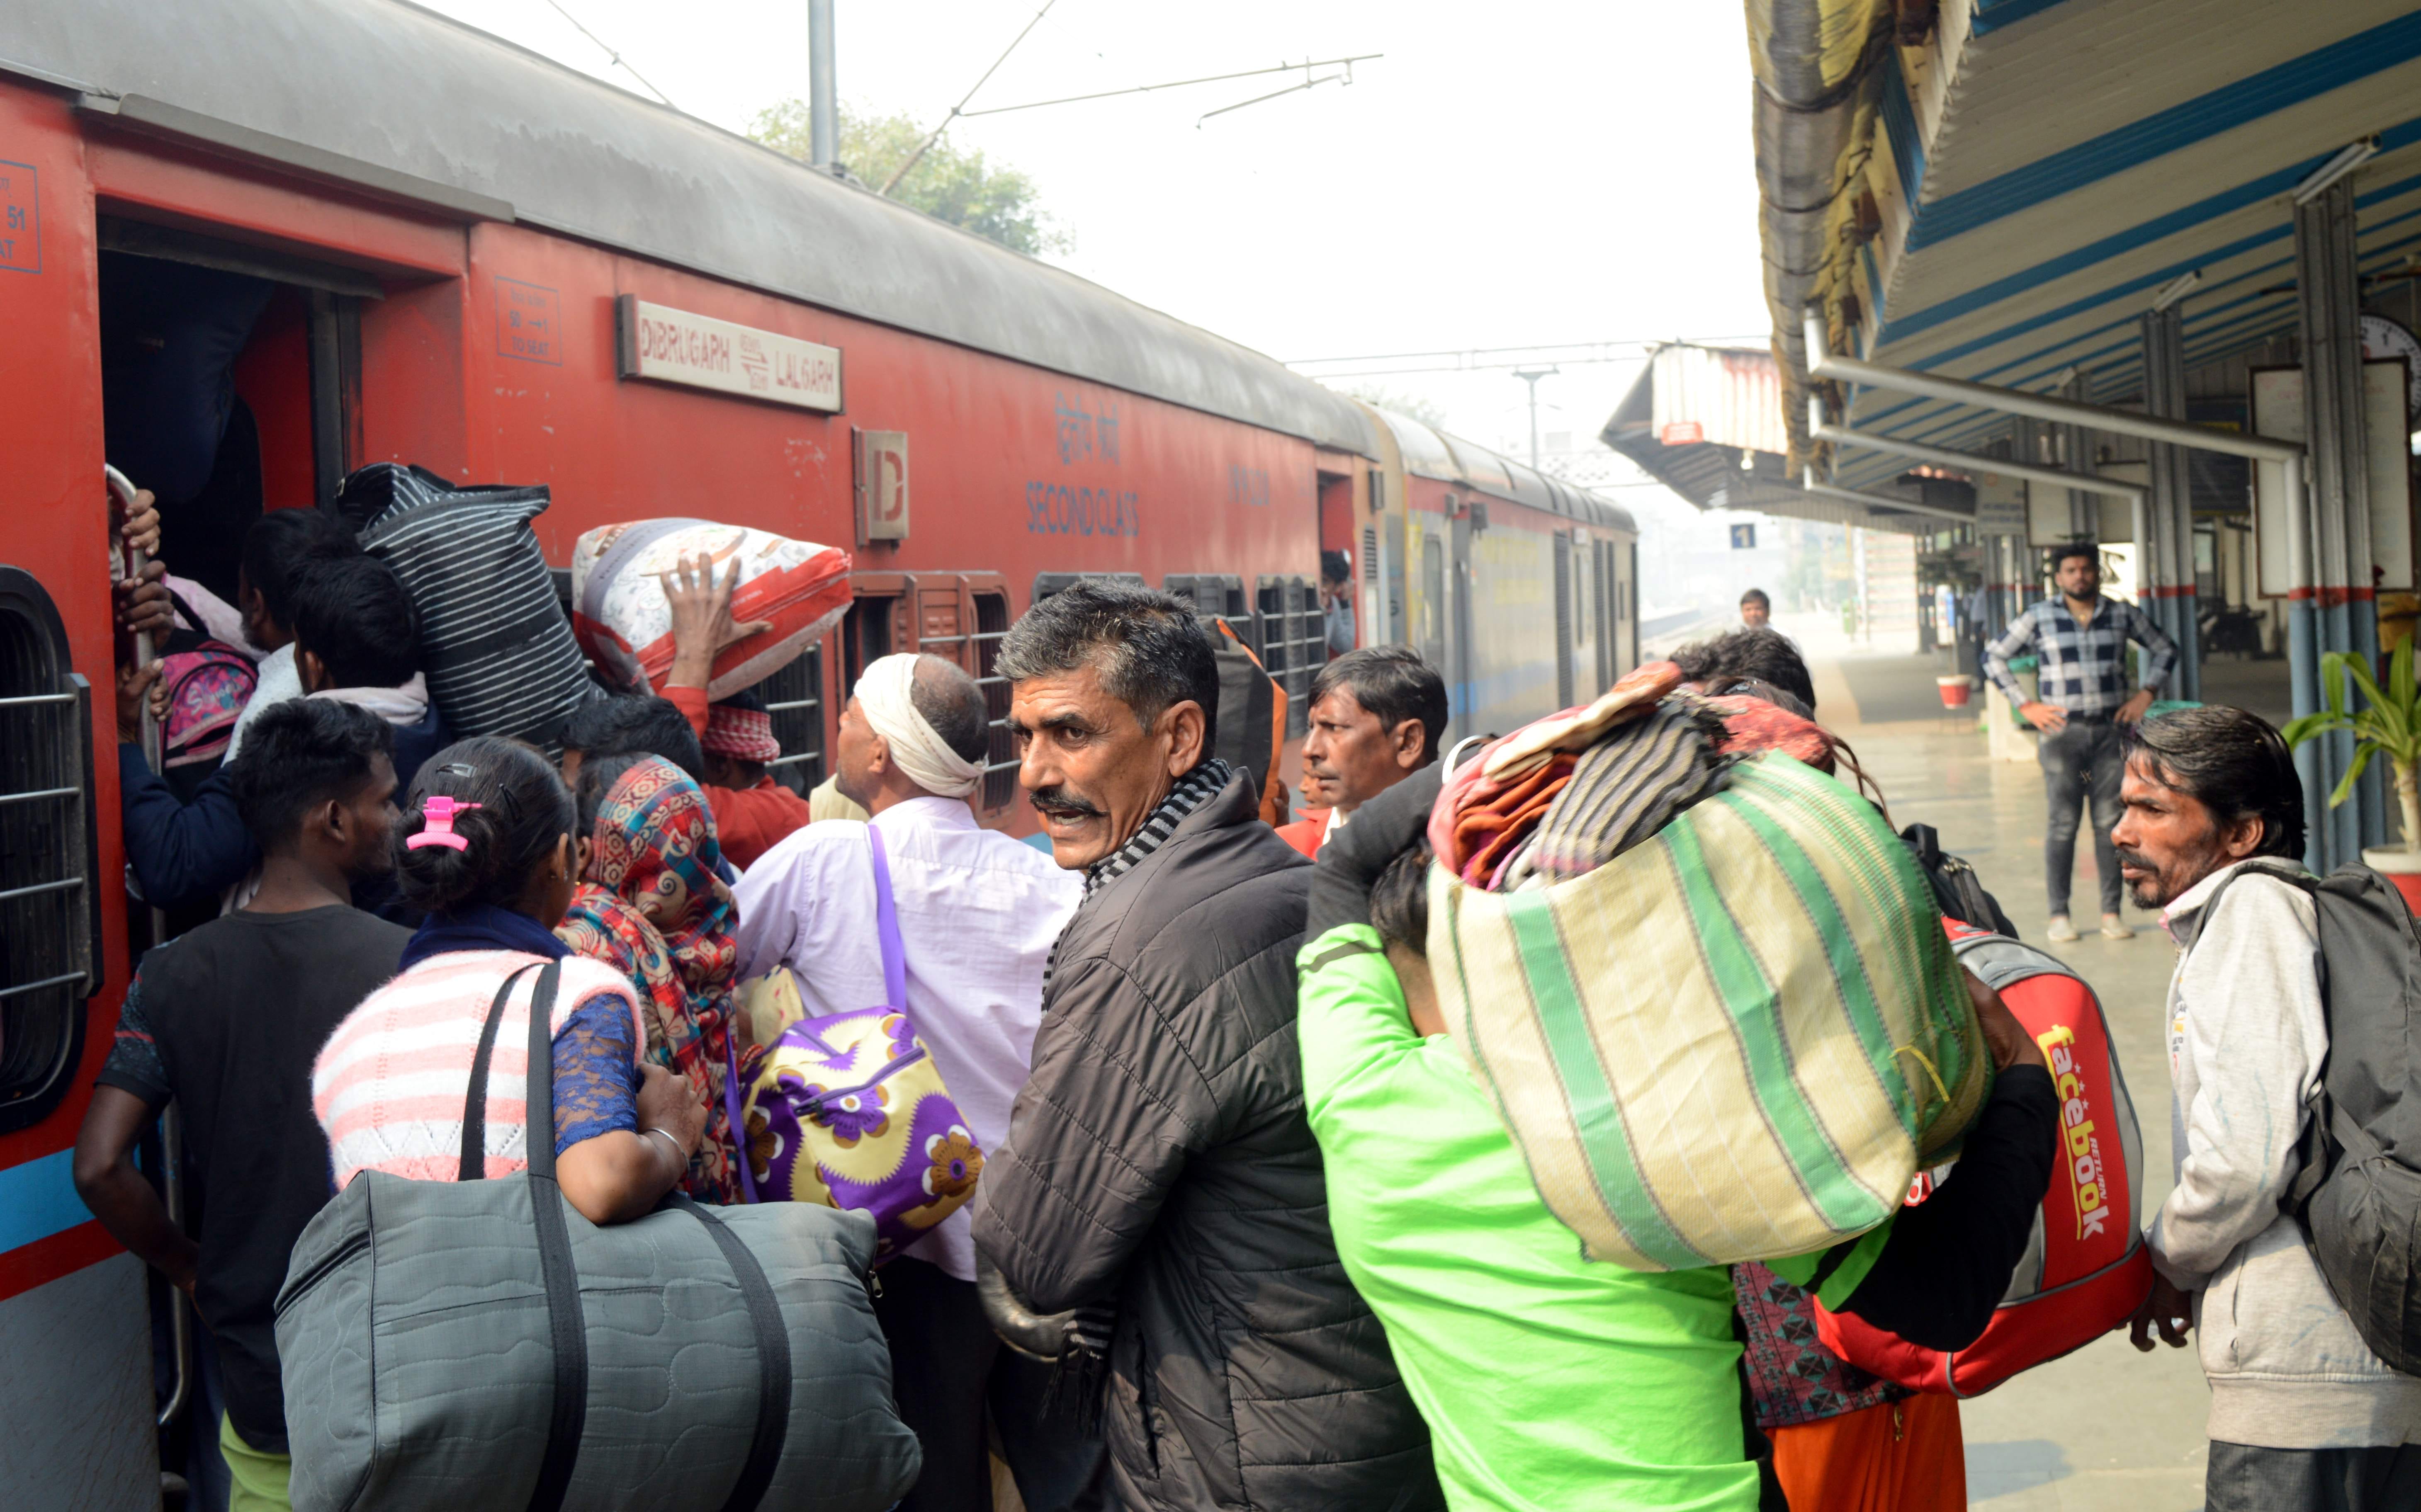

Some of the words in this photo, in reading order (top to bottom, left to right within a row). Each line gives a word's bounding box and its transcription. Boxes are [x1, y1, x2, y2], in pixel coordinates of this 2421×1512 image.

[8, 205, 25, 231] 51
[511, 337, 525, 352] TO
[527, 339, 549, 357] SEAT
[642, 318, 730, 374] DIBRUGARH
[775, 352, 834, 394] LALGARH
[874, 450, 903, 521] D
[1026, 481, 1094, 536] SECOND
[1096, 488, 1139, 537] CLASS
[2037, 1024, 2110, 1240] facebook
[2090, 1137, 2107, 1199] RETURN
